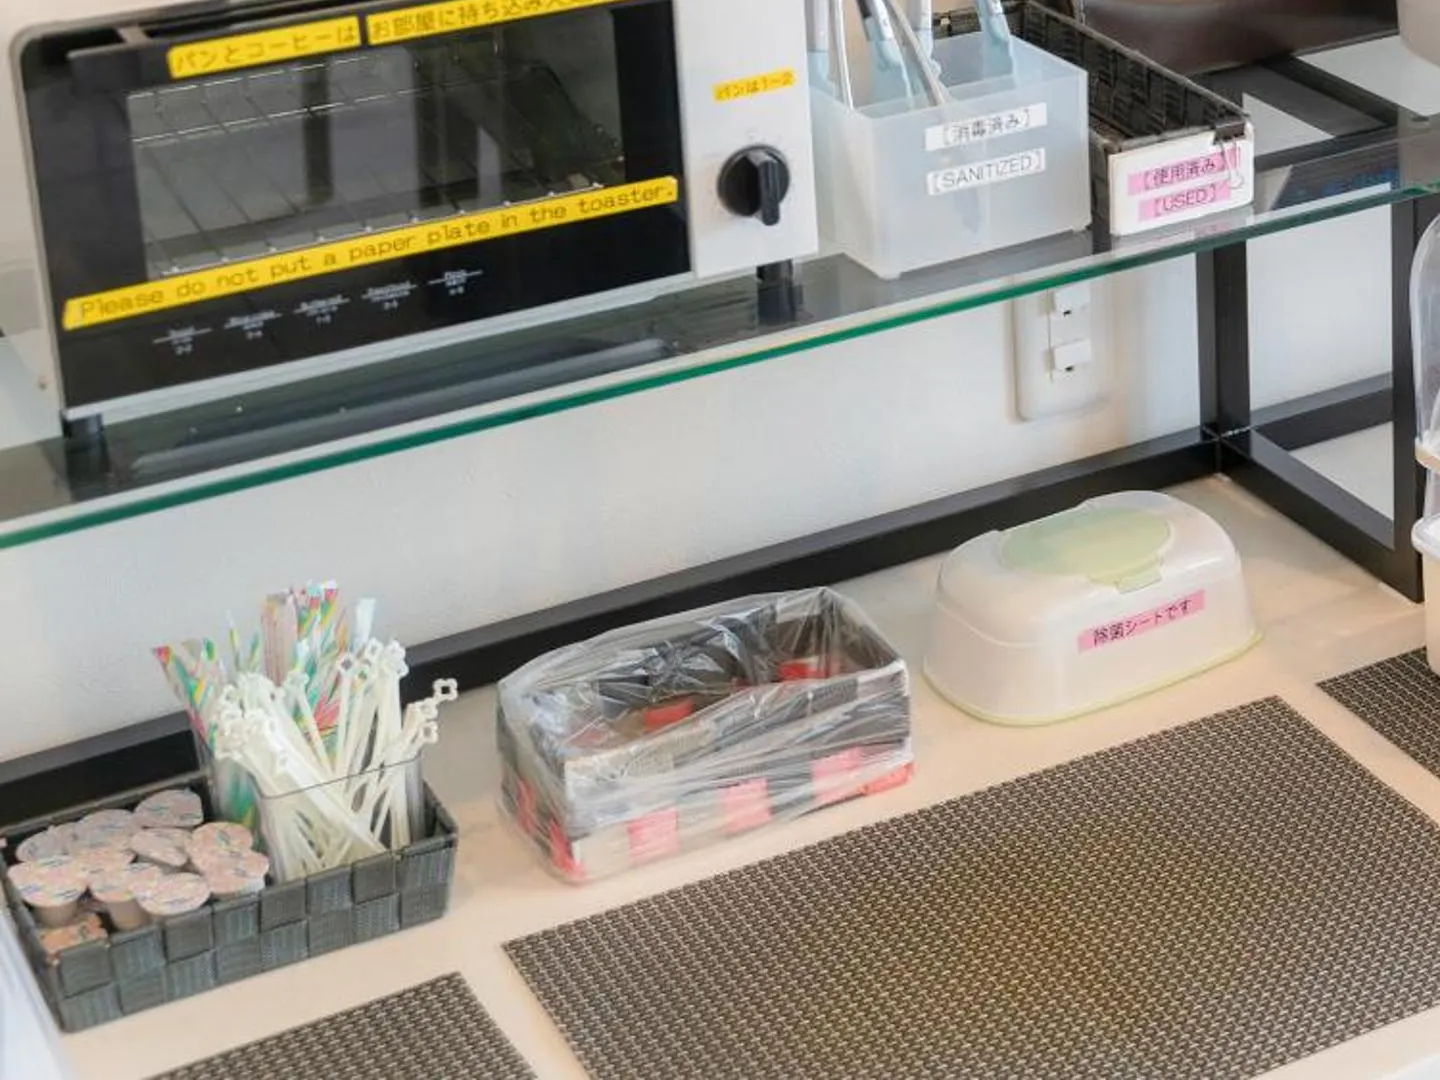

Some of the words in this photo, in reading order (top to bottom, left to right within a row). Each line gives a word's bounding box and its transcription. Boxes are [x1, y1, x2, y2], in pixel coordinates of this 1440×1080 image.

[176, 25, 356, 72] パンとコーヒーは
[80, 289, 165, 319] Please
[176, 280, 206, 298] do
[216, 269, 260, 289] not
[269, 256, 313, 279] put
[323, 251, 337, 266] a
[349, 233, 416, 261] paper
[427, 219, 491, 245] plate
[500, 211, 518, 228] in
[529, 204, 567, 222] the
[576, 184, 674, 214] toaster.
[1093, 599, 1192, 646] 除菌シートです
